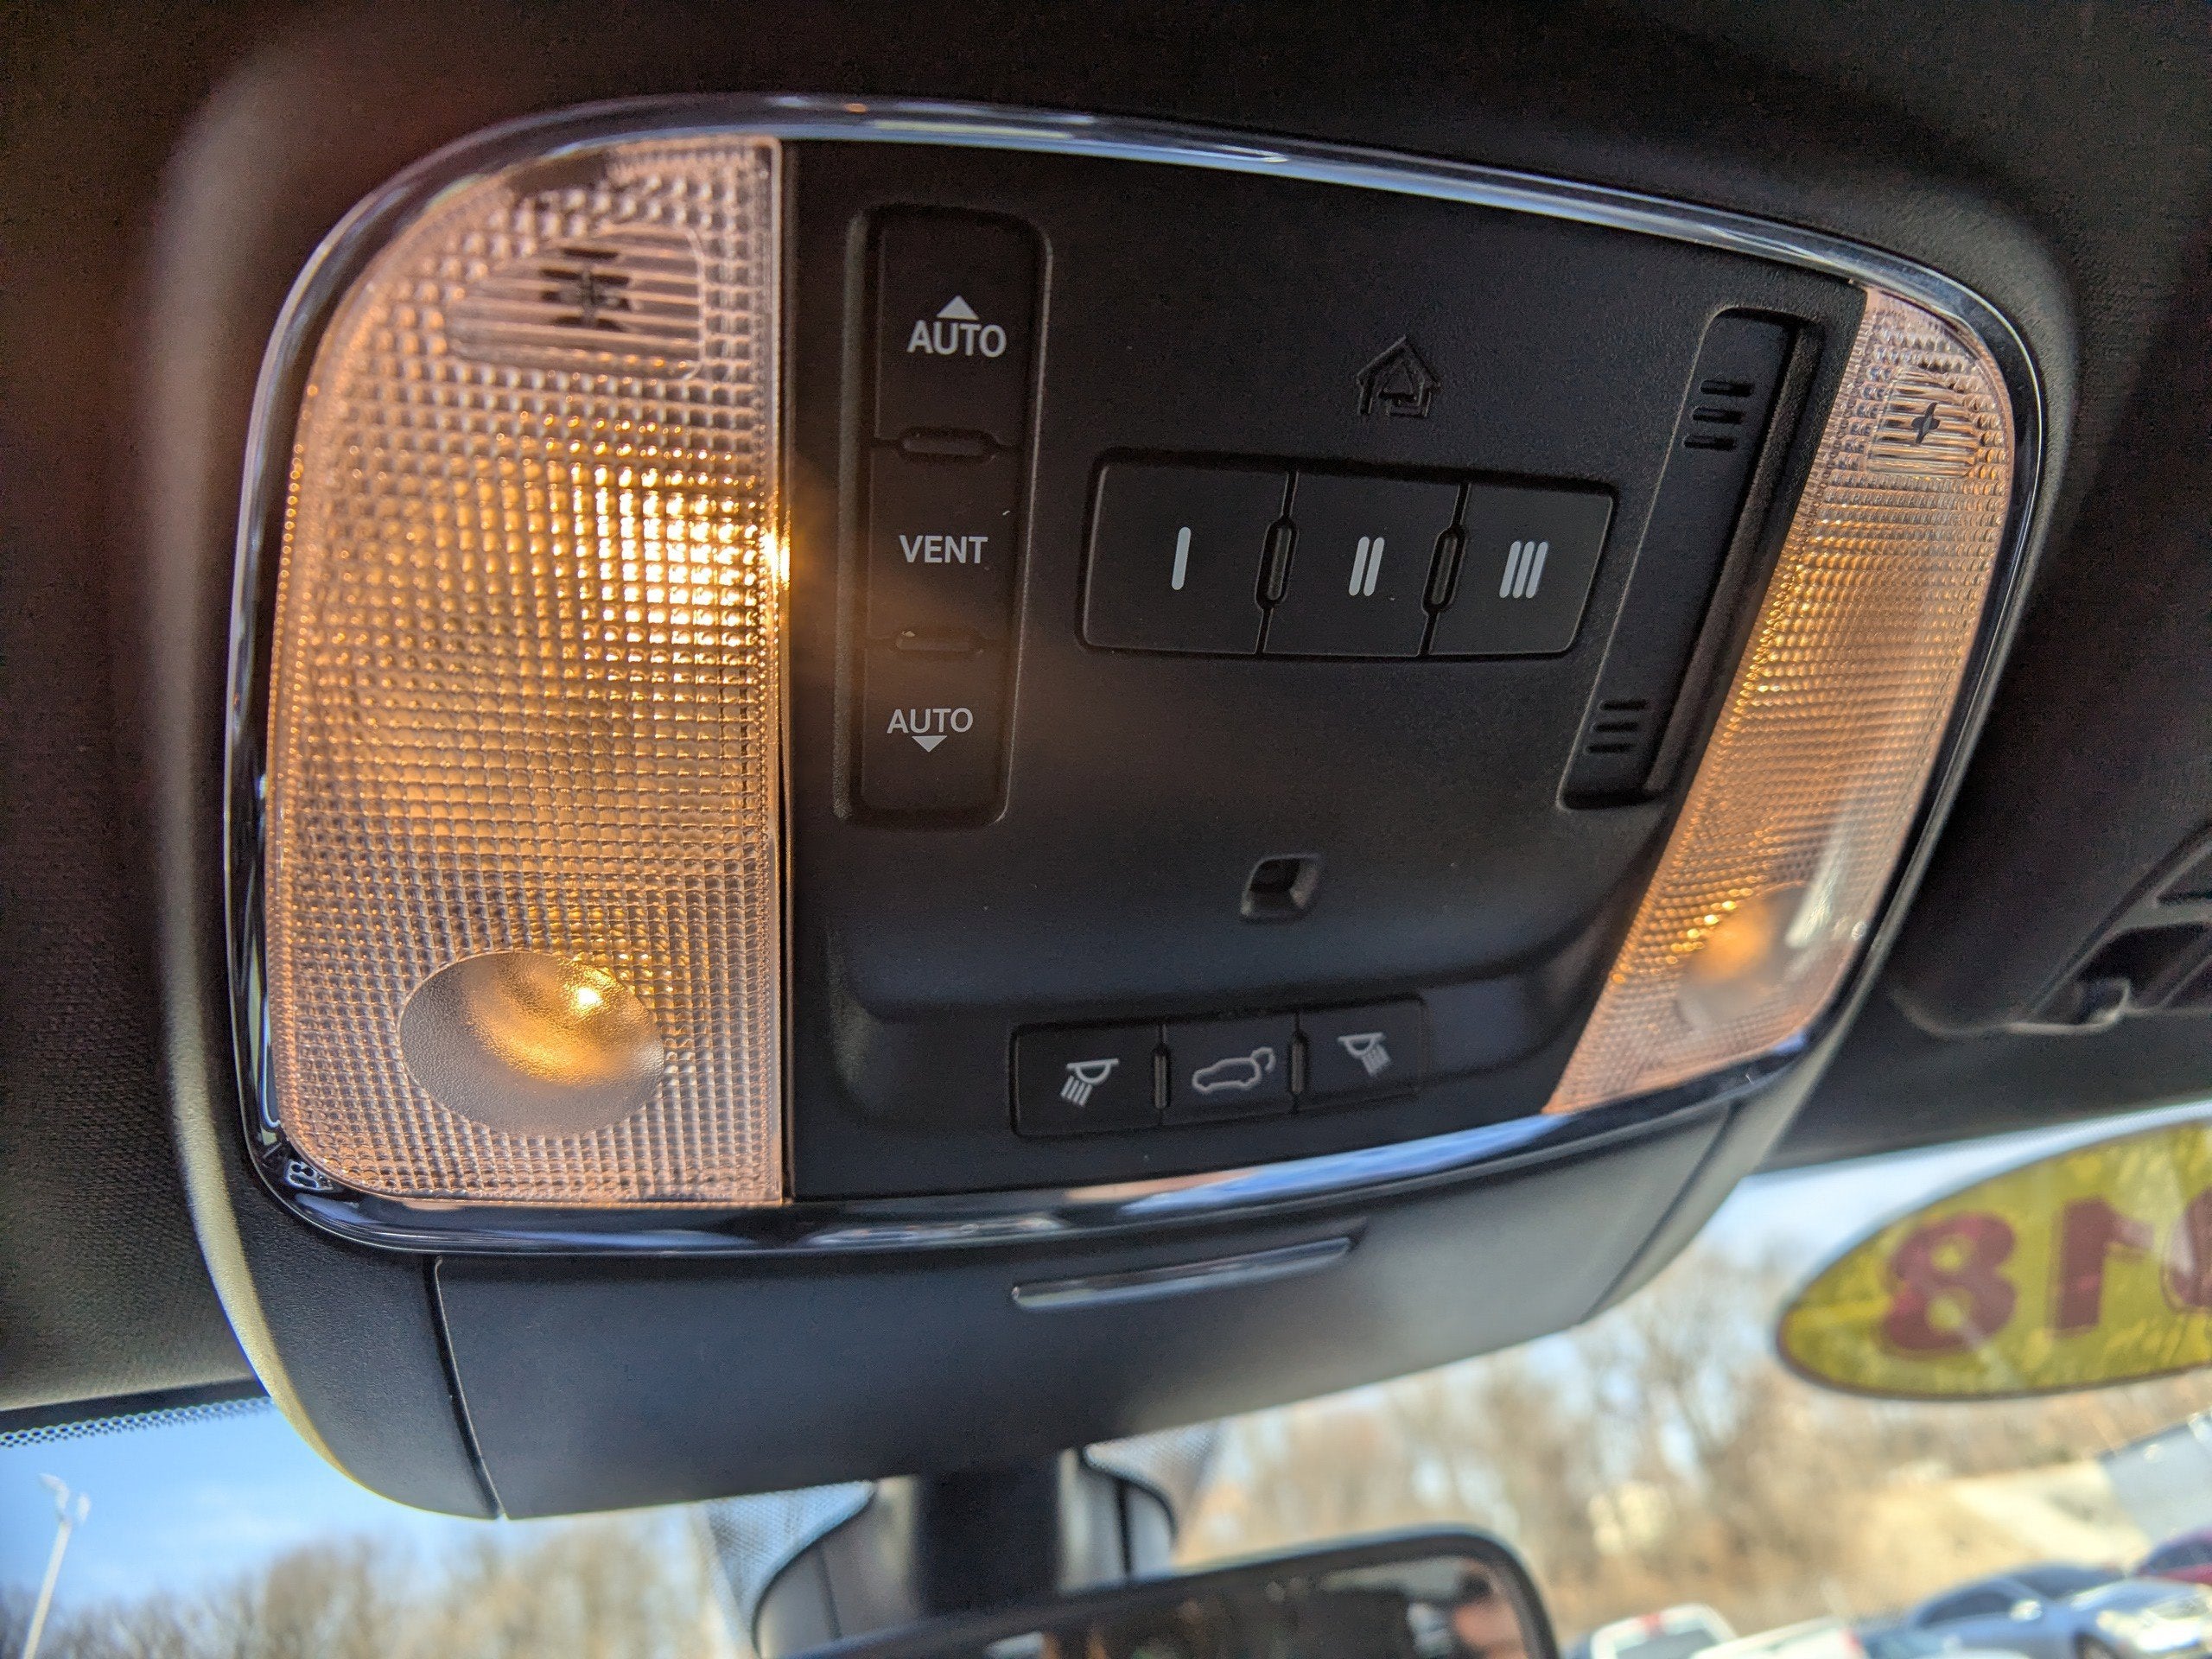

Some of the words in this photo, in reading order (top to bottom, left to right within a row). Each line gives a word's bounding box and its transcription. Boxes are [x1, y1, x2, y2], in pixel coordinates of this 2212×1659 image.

[907, 319, 1007, 358] AUTO
[899, 534, 988, 563] VENT
[887, 707, 975, 734] AUTO
